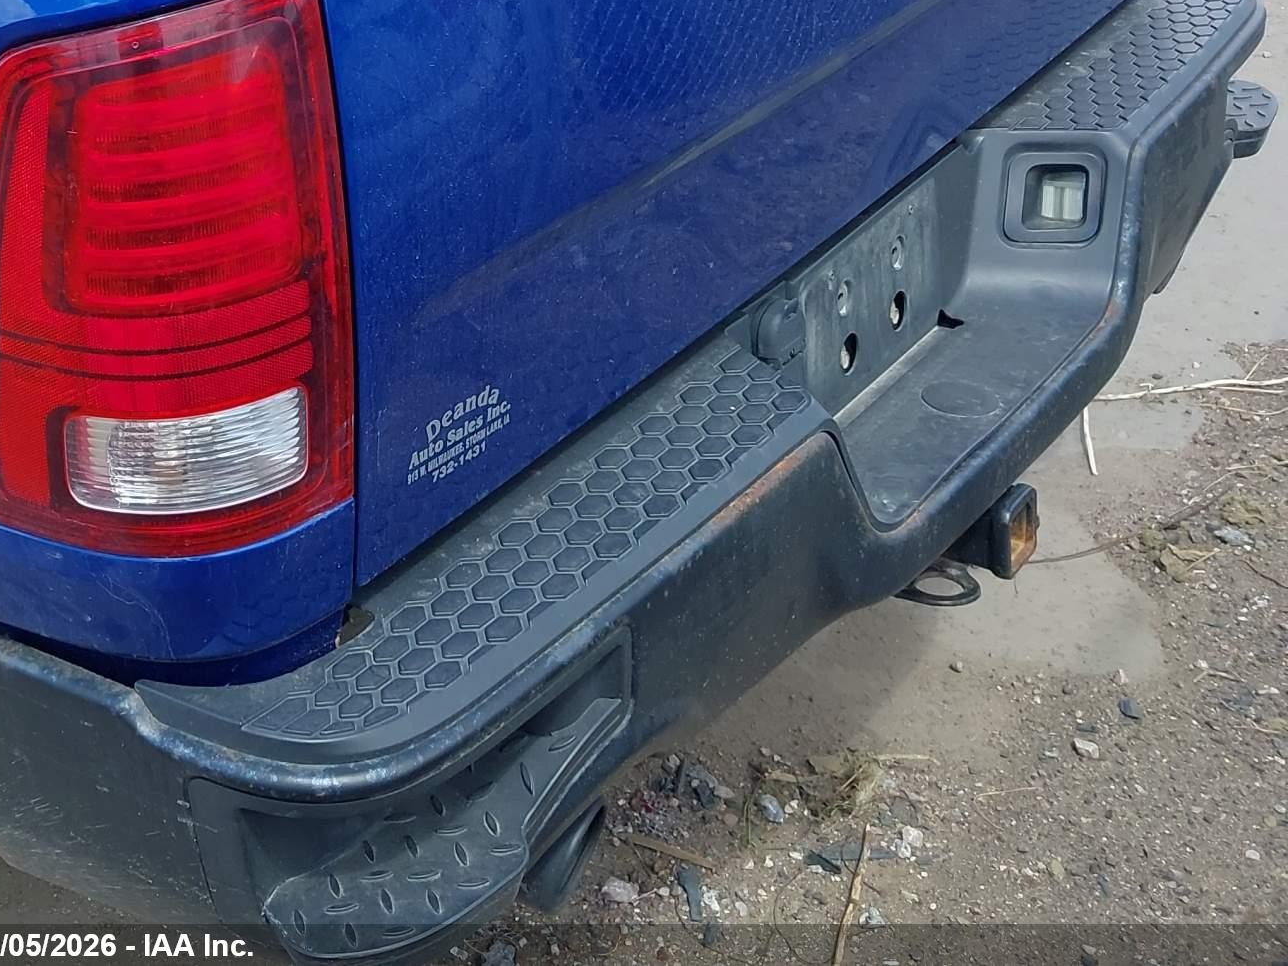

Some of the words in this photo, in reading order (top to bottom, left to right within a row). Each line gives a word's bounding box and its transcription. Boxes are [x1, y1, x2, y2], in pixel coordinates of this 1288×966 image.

[408, 439, 444, 470] Auto
[447, 414, 483, 446] Sales
[487, 400, 511, 422] Inc.
[425, 385, 500, 443] Deanda
[465, 428, 485, 449] STORM
